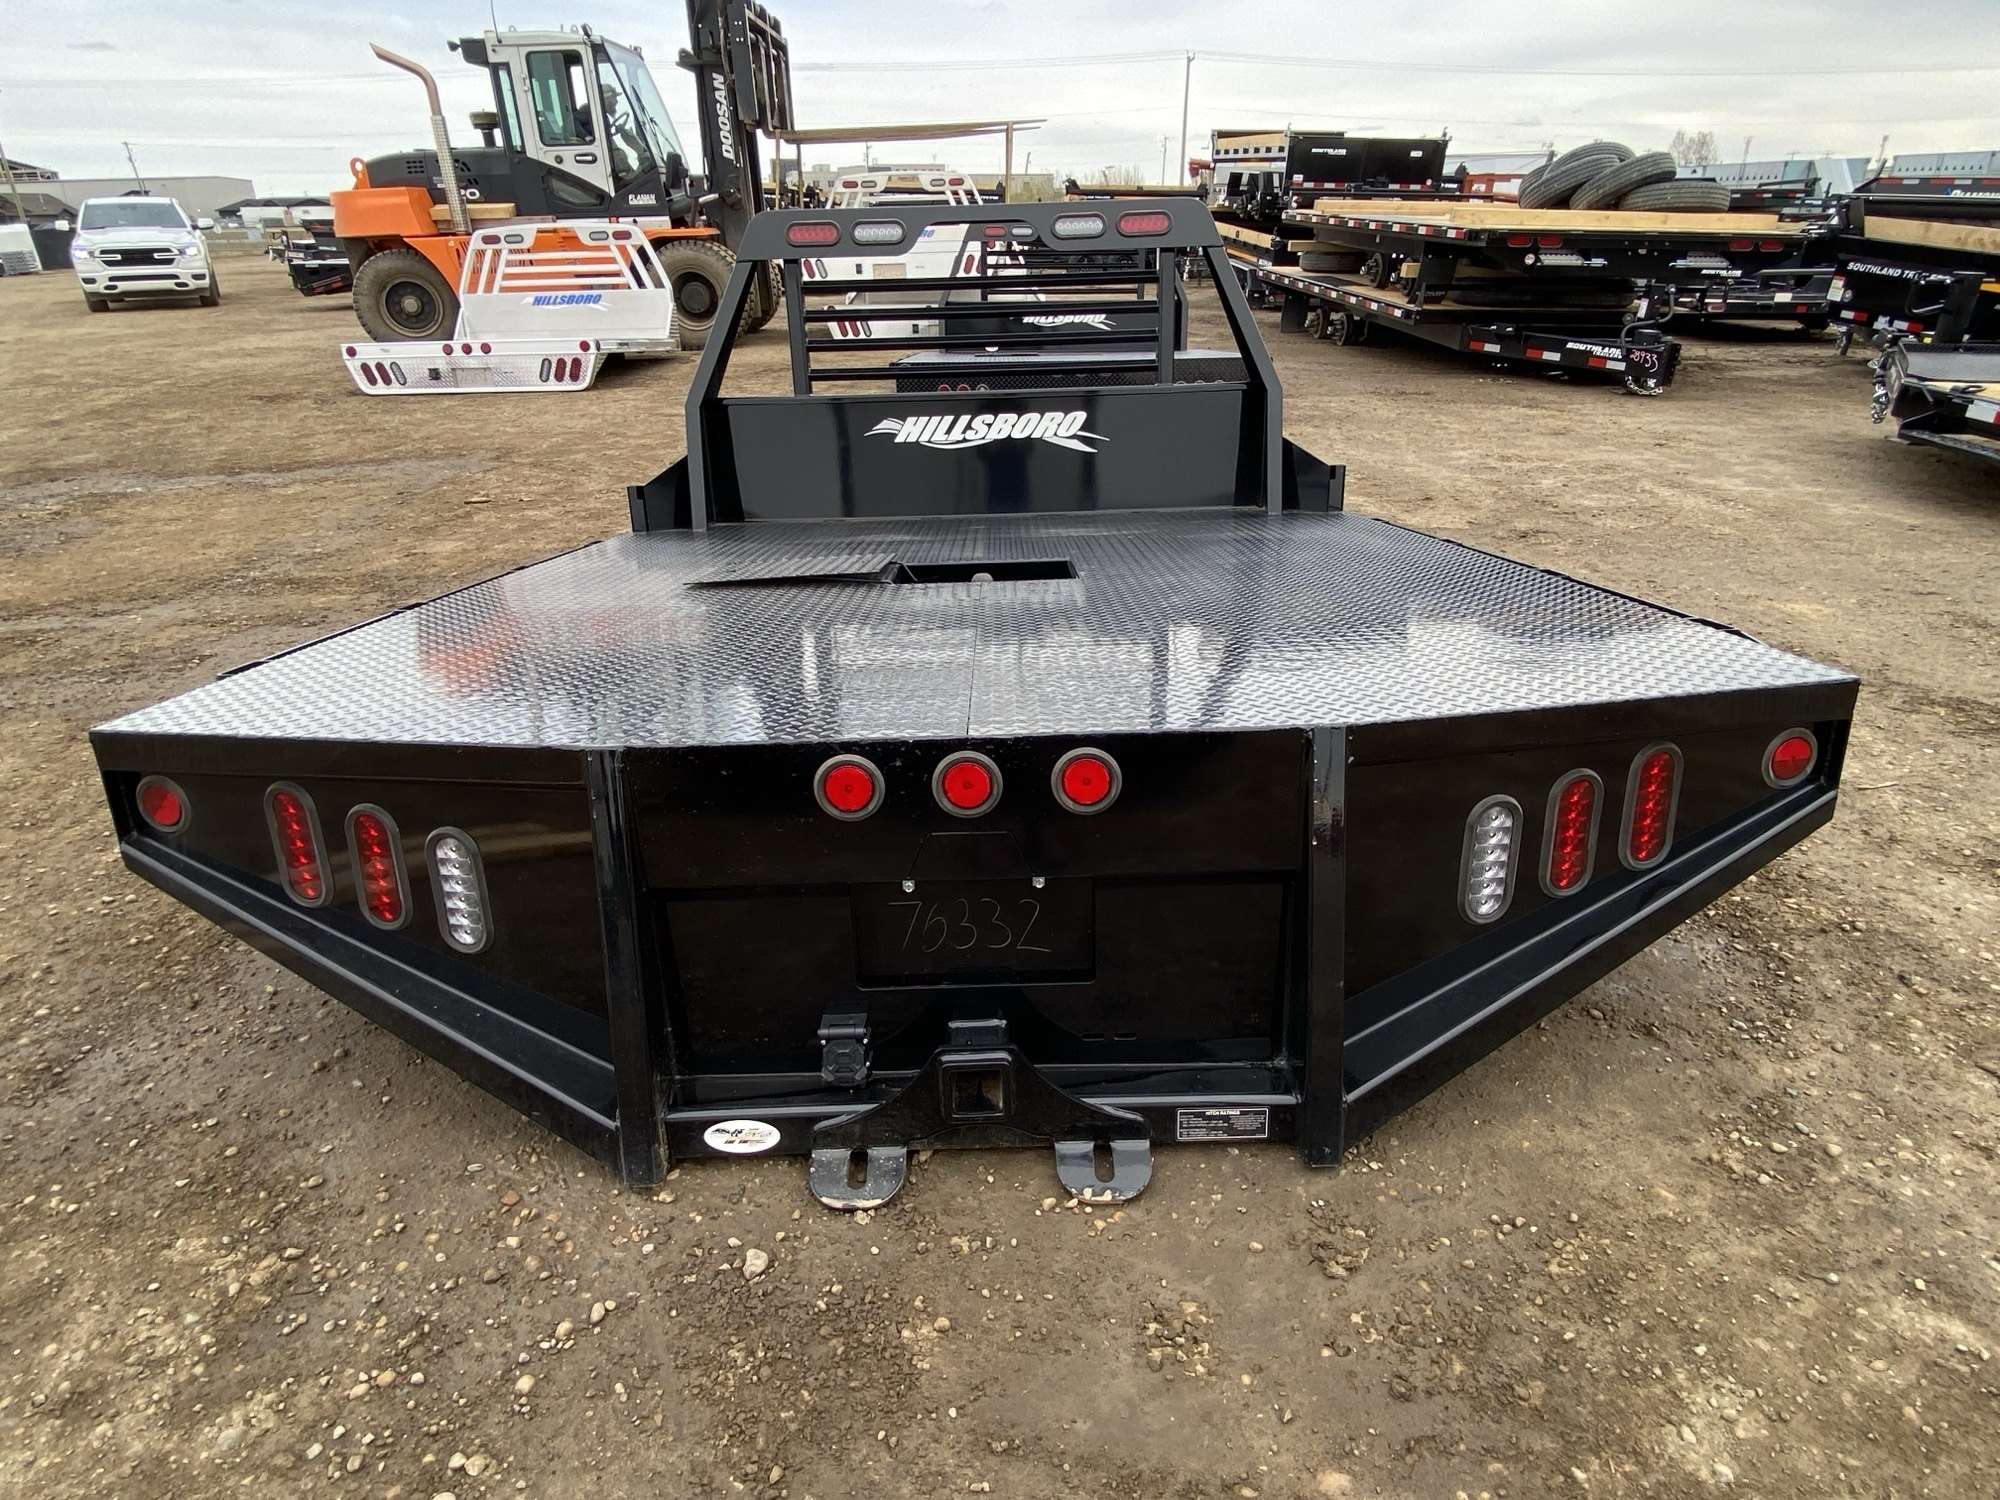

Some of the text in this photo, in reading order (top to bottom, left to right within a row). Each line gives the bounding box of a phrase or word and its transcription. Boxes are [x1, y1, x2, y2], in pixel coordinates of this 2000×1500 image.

[712, 72, 735, 160] DOOSAN
[1846, 262, 1902, 277] SOUTHLAND
[532, 294, 602, 306] HILLSBORO
[1566, 342, 1622, 353] SOUTHLAND
[894, 411, 1087, 443] HILLSBORO
